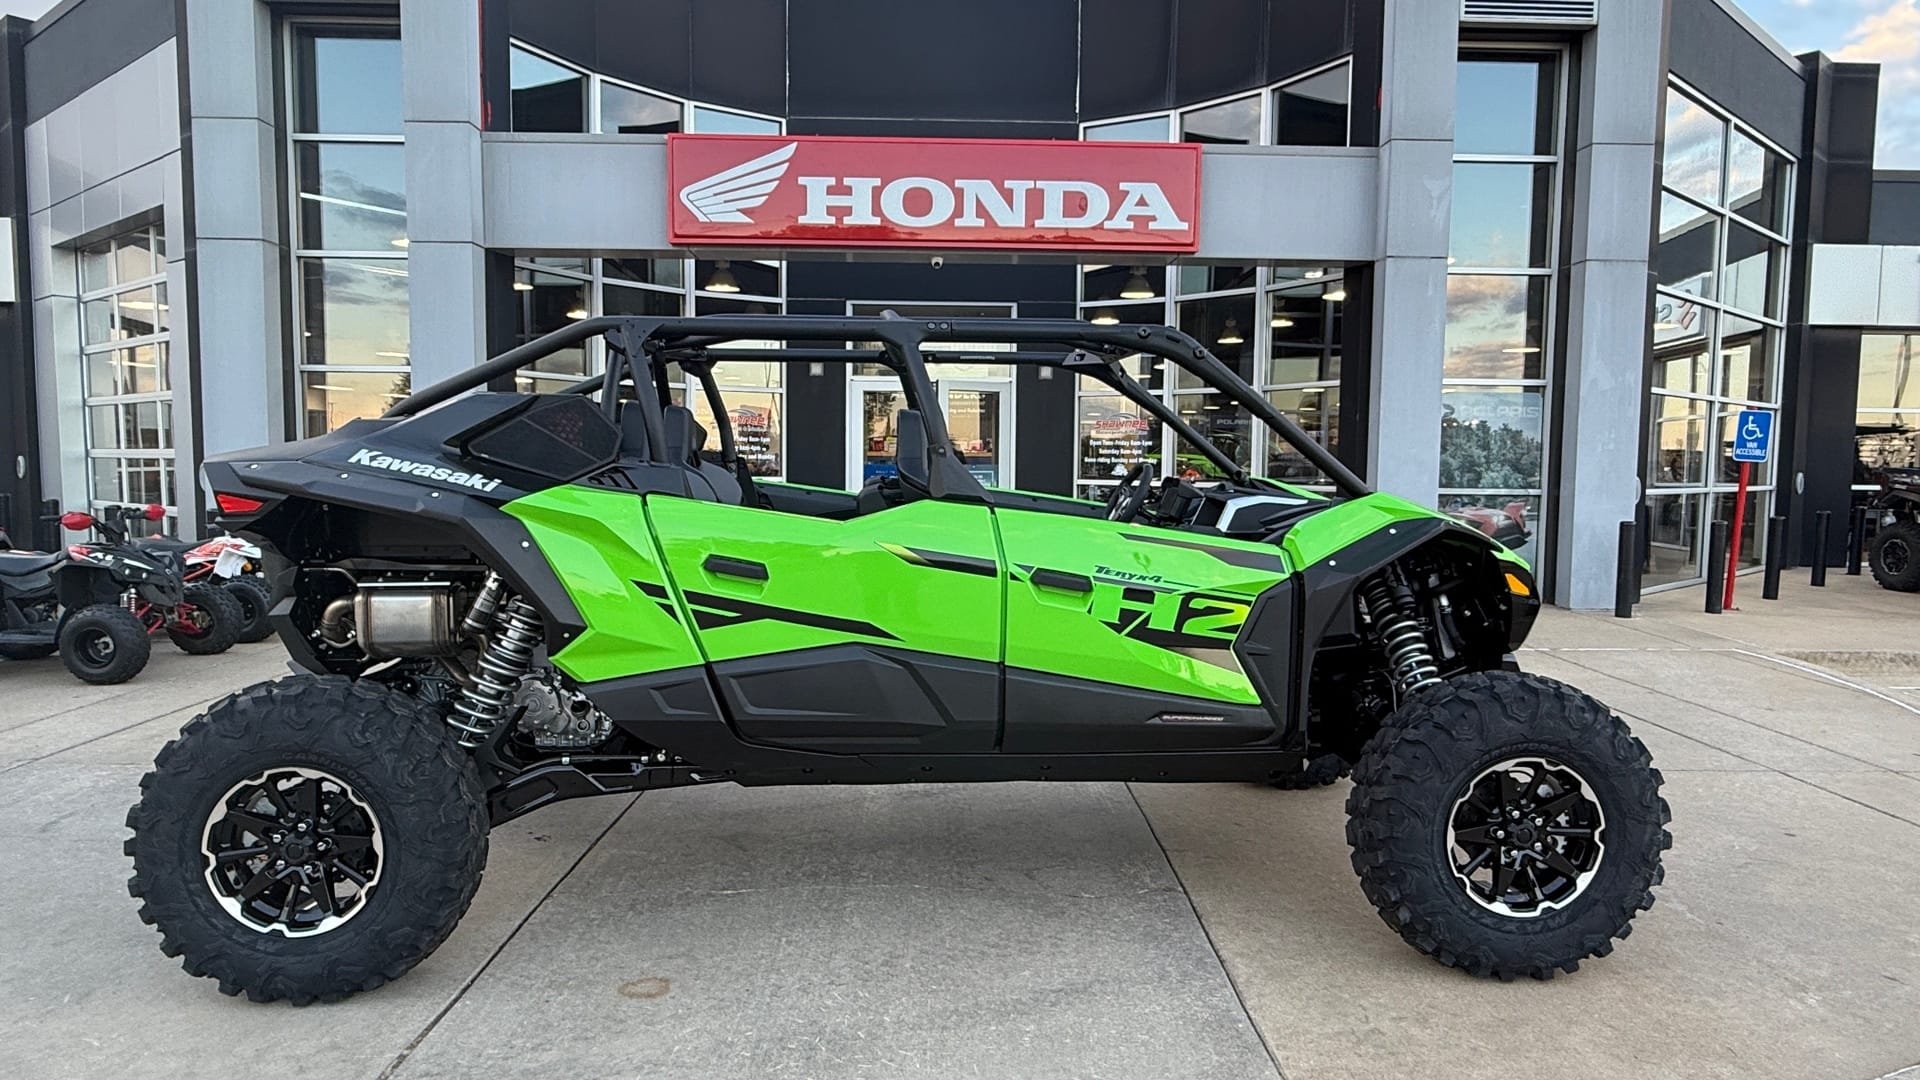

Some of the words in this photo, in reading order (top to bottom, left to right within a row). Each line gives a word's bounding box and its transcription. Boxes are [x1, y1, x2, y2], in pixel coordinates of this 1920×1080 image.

[797, 177, 1189, 231] HONDA
[1735, 448, 1766, 457] ACCESSIBLE
[1746, 441, 1758, 449] VAN
[348, 448, 502, 493] Kawasaki
[1089, 582, 1252, 641] H2
